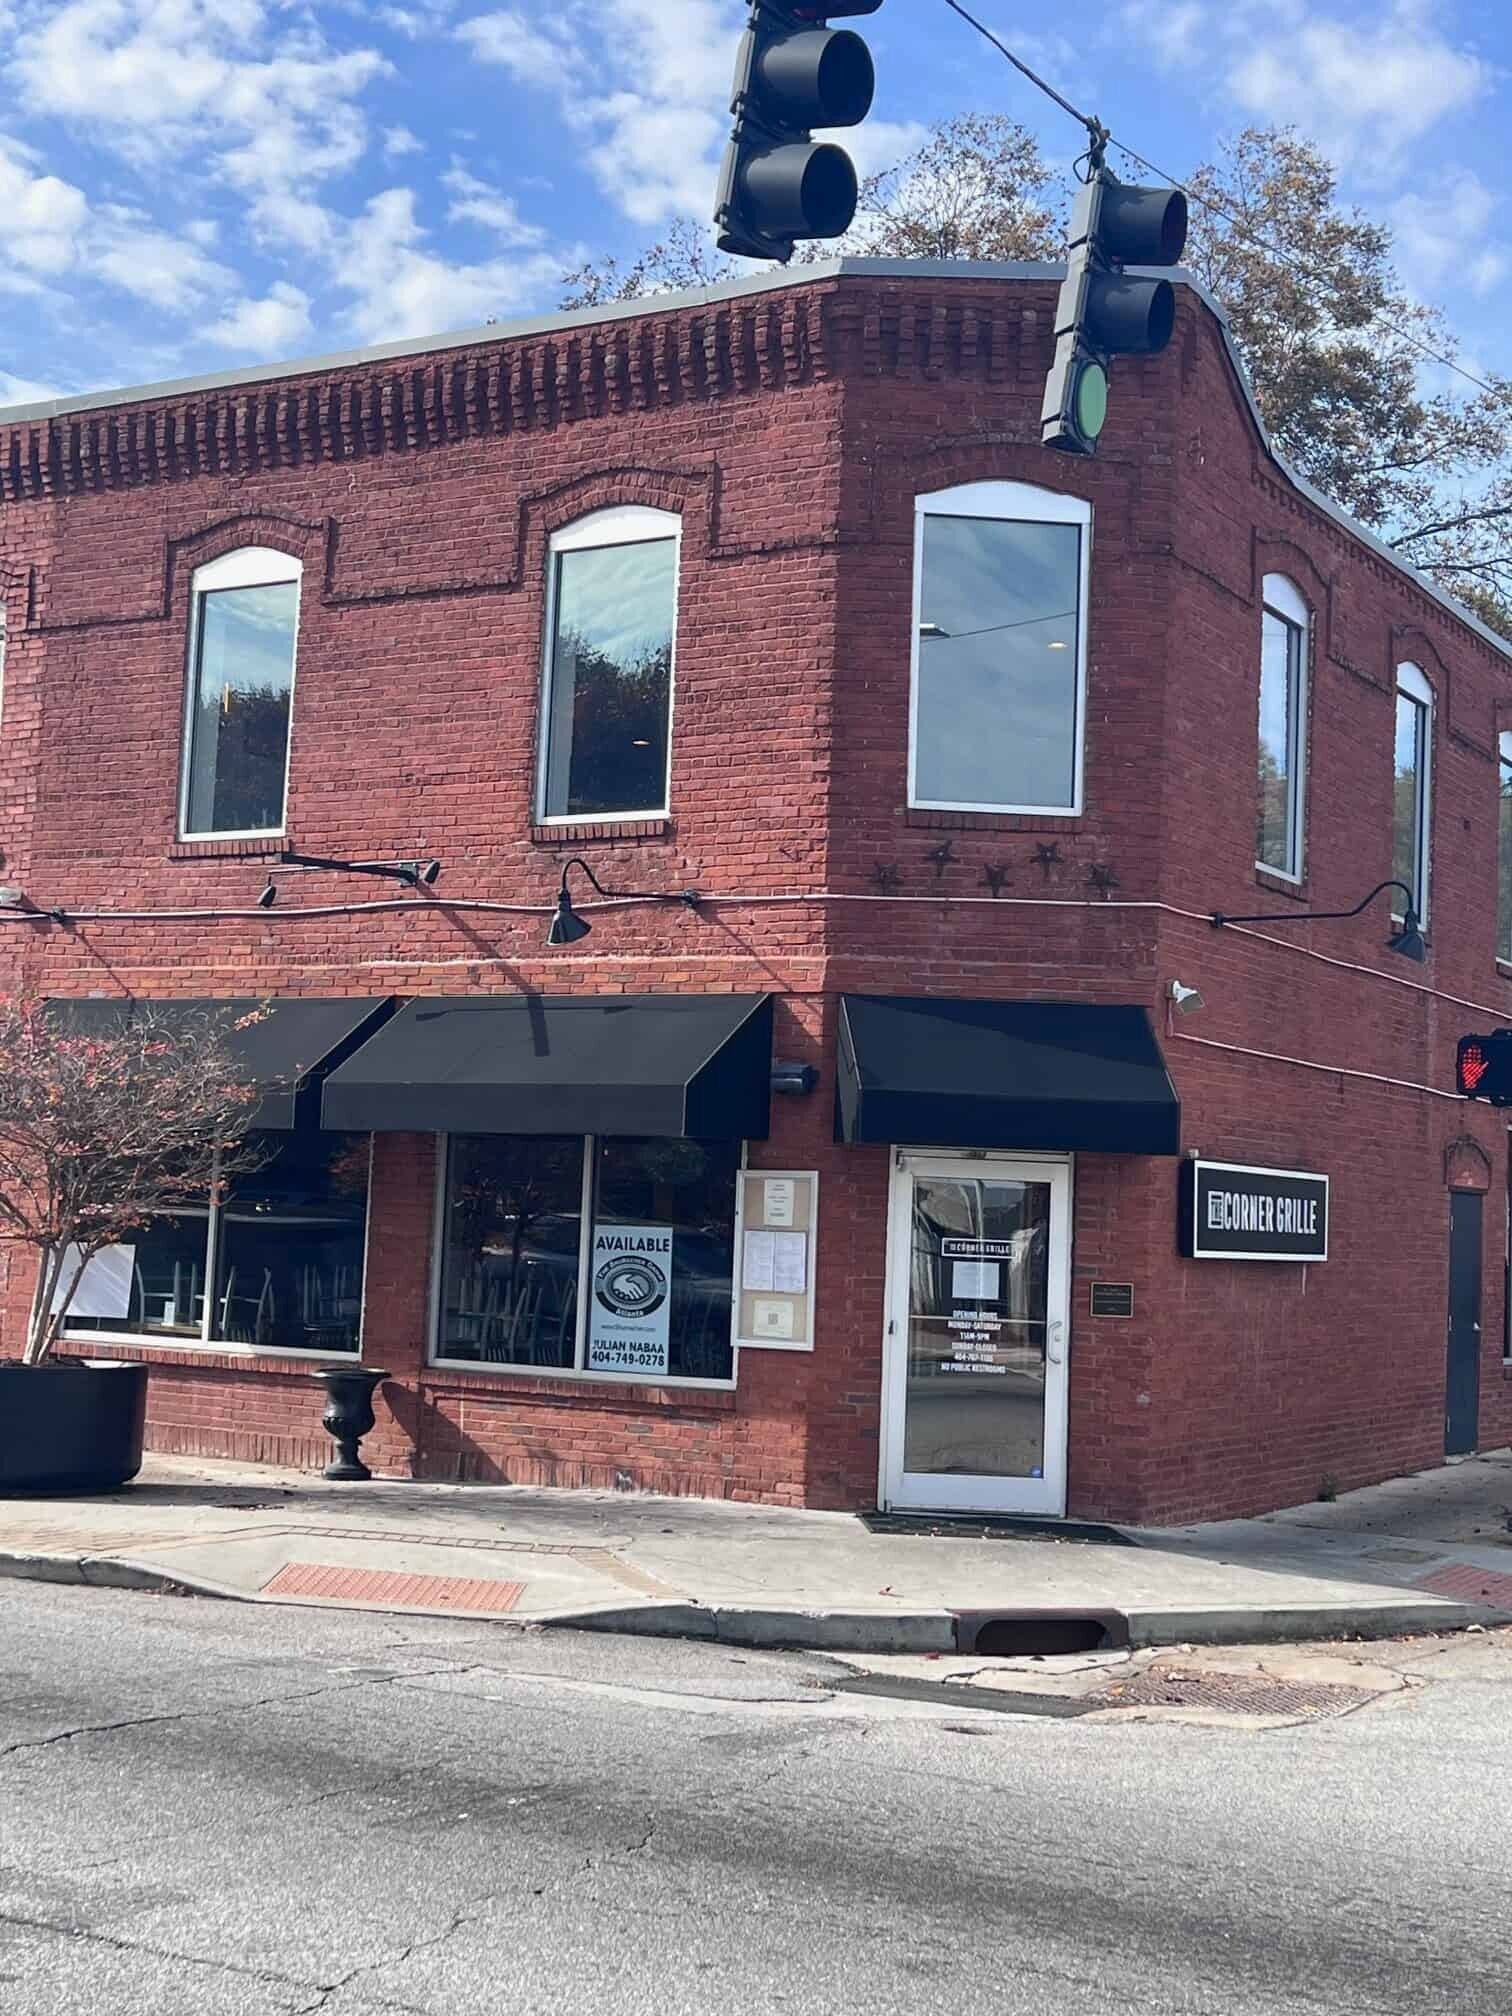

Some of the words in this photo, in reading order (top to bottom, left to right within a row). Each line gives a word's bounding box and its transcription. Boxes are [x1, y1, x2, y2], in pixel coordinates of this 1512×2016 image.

[1225, 1191, 1274, 1233] CORNER
[1276, 1197, 1317, 1234] GRILLE
[596, 1235, 670, 1252] AVAILABLE
[592, 1338, 627, 1351] JULIAN
[629, 1341, 665, 1353] NABAA
[591, 1350, 665, 1367] 404-749-0278
